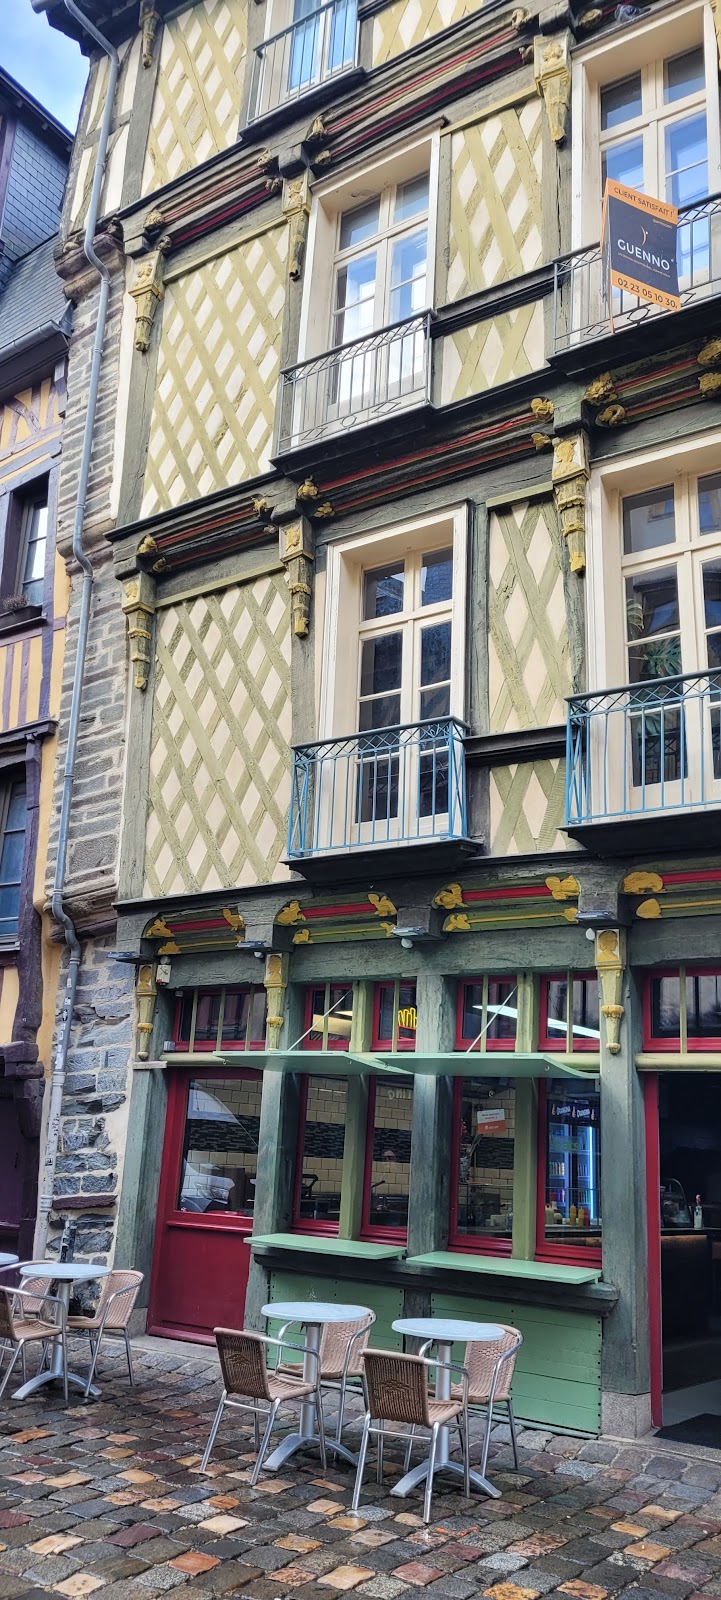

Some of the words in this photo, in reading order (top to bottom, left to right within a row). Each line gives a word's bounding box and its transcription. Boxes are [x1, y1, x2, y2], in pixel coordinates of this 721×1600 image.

[613, 187, 637, 202] CLIENT
[638, 197, 670, 216] SATISFAIT
[617, 239, 670, 271] GUENNO
[617, 277, 629, 289] 02
[630, 283, 640, 293] 23
[642, 288, 653, 299] 05
[654, 293, 664, 303] 10
